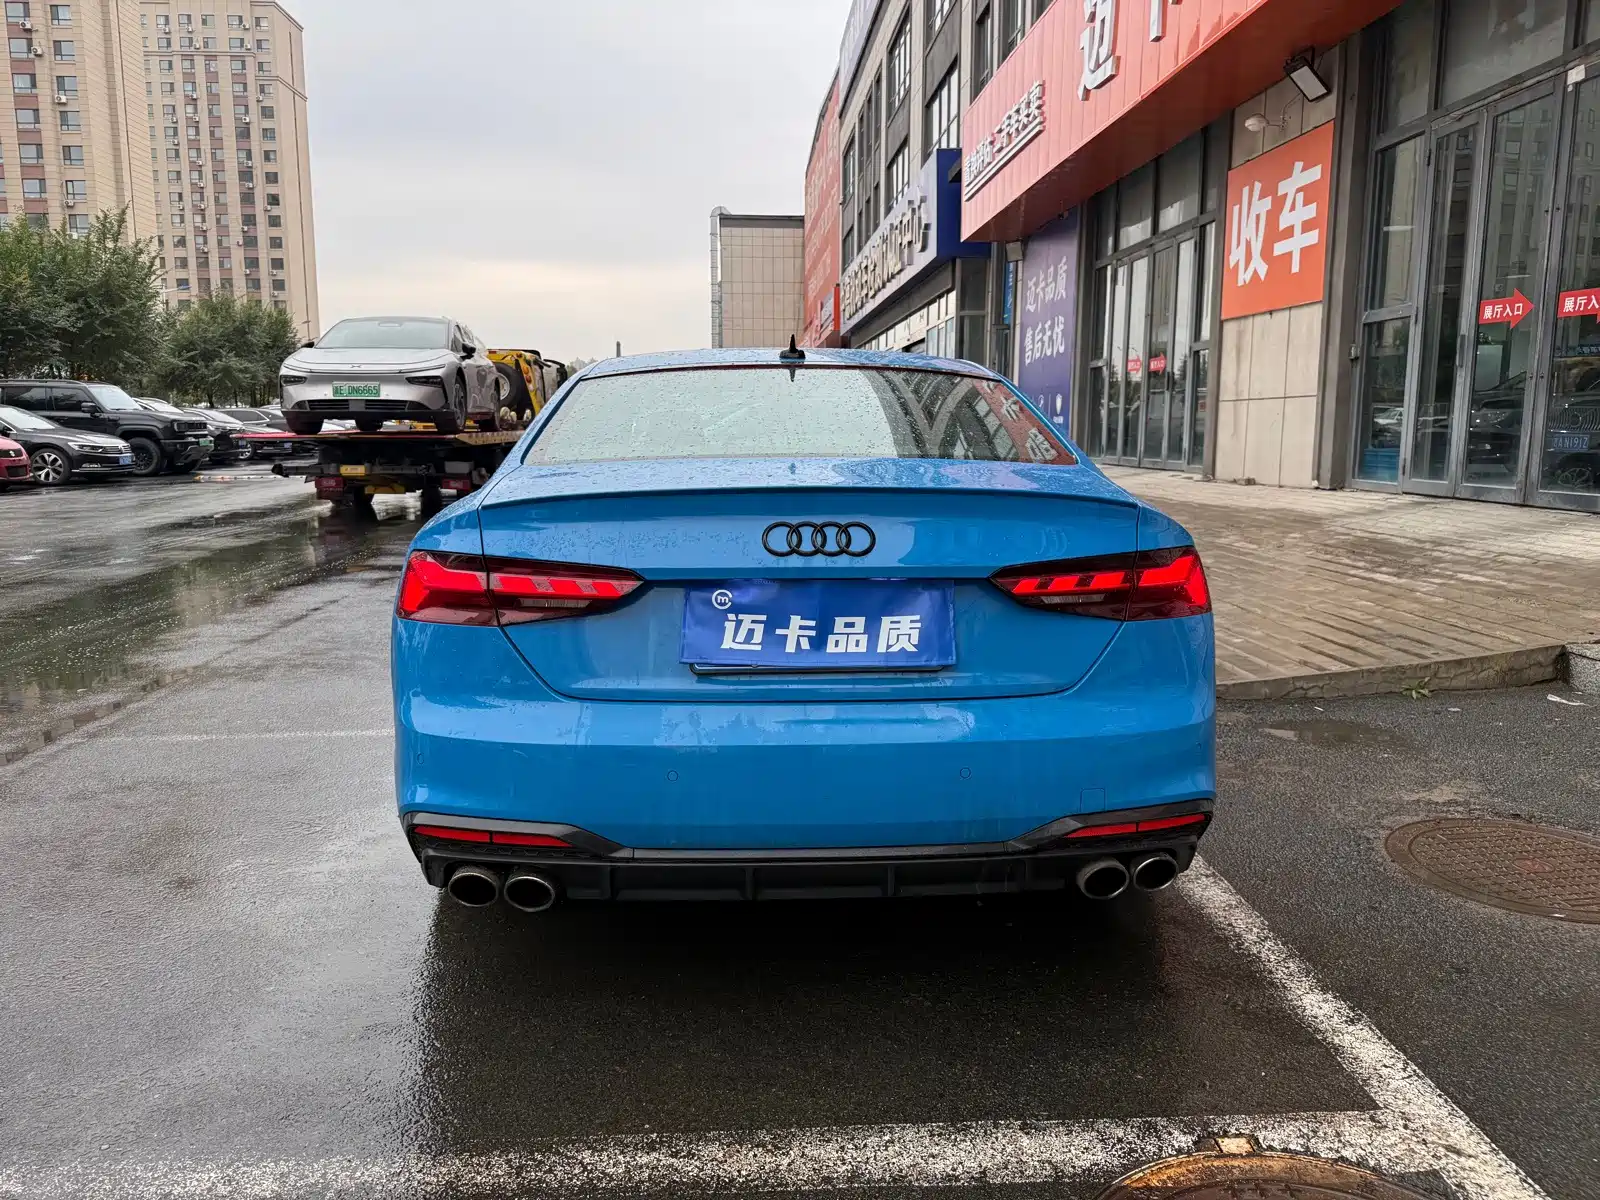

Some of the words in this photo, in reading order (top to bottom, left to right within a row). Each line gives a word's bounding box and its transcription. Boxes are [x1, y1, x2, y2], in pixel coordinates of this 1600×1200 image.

[1229, 161, 1322, 286] 收车
[1026, 256, 1068, 313] 迈卡品质
[1483, 303, 1523, 320] 展厅入口
[1024, 315, 1065, 366] 售后无忧
[720, 613, 922, 653] 迈卡品质
